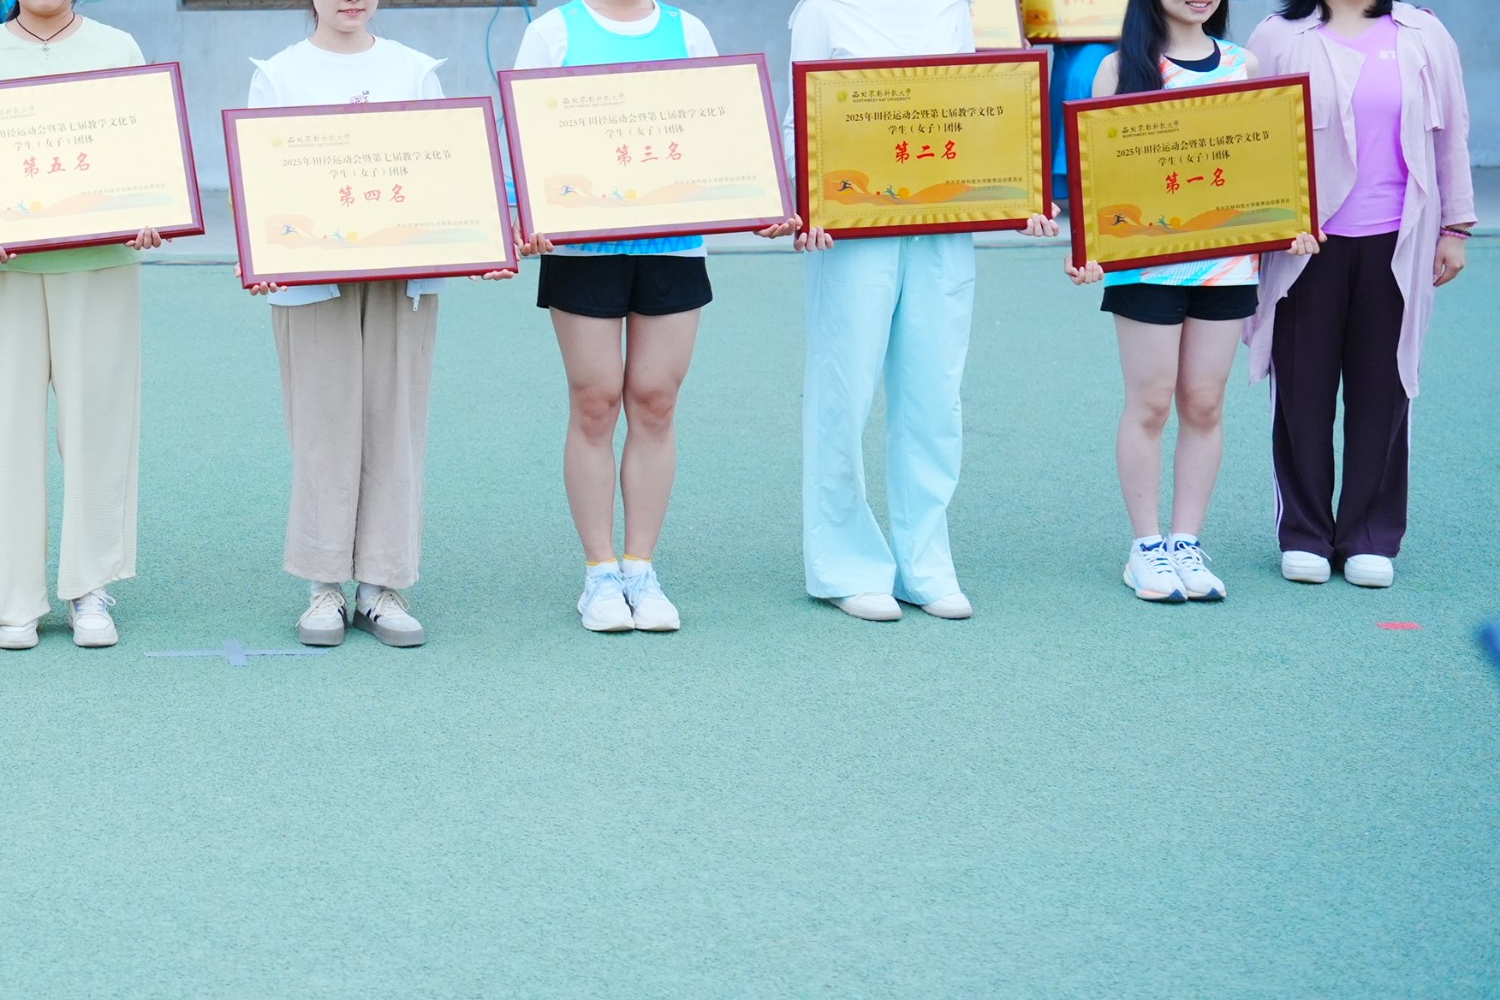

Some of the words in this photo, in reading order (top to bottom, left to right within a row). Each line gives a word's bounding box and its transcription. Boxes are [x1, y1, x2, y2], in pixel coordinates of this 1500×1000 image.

[846, 106, 1004, 122] 2025年田径运动会暨第七届教学文化节
[888, 123, 963, 134] 学生（女子）团体
[615, 141, 683, 167] 第三名
[895, 140, 958, 164] 第二名
[1116, 130, 1270, 158] 2025年田径运动会暨第七届教学文化节
[23, 152, 91, 178] 第五名
[1158, 151, 1230, 166] 学生（女子）团体
[1165, 167, 1226, 194] 第一名
[339, 184, 406, 207] 第四名
